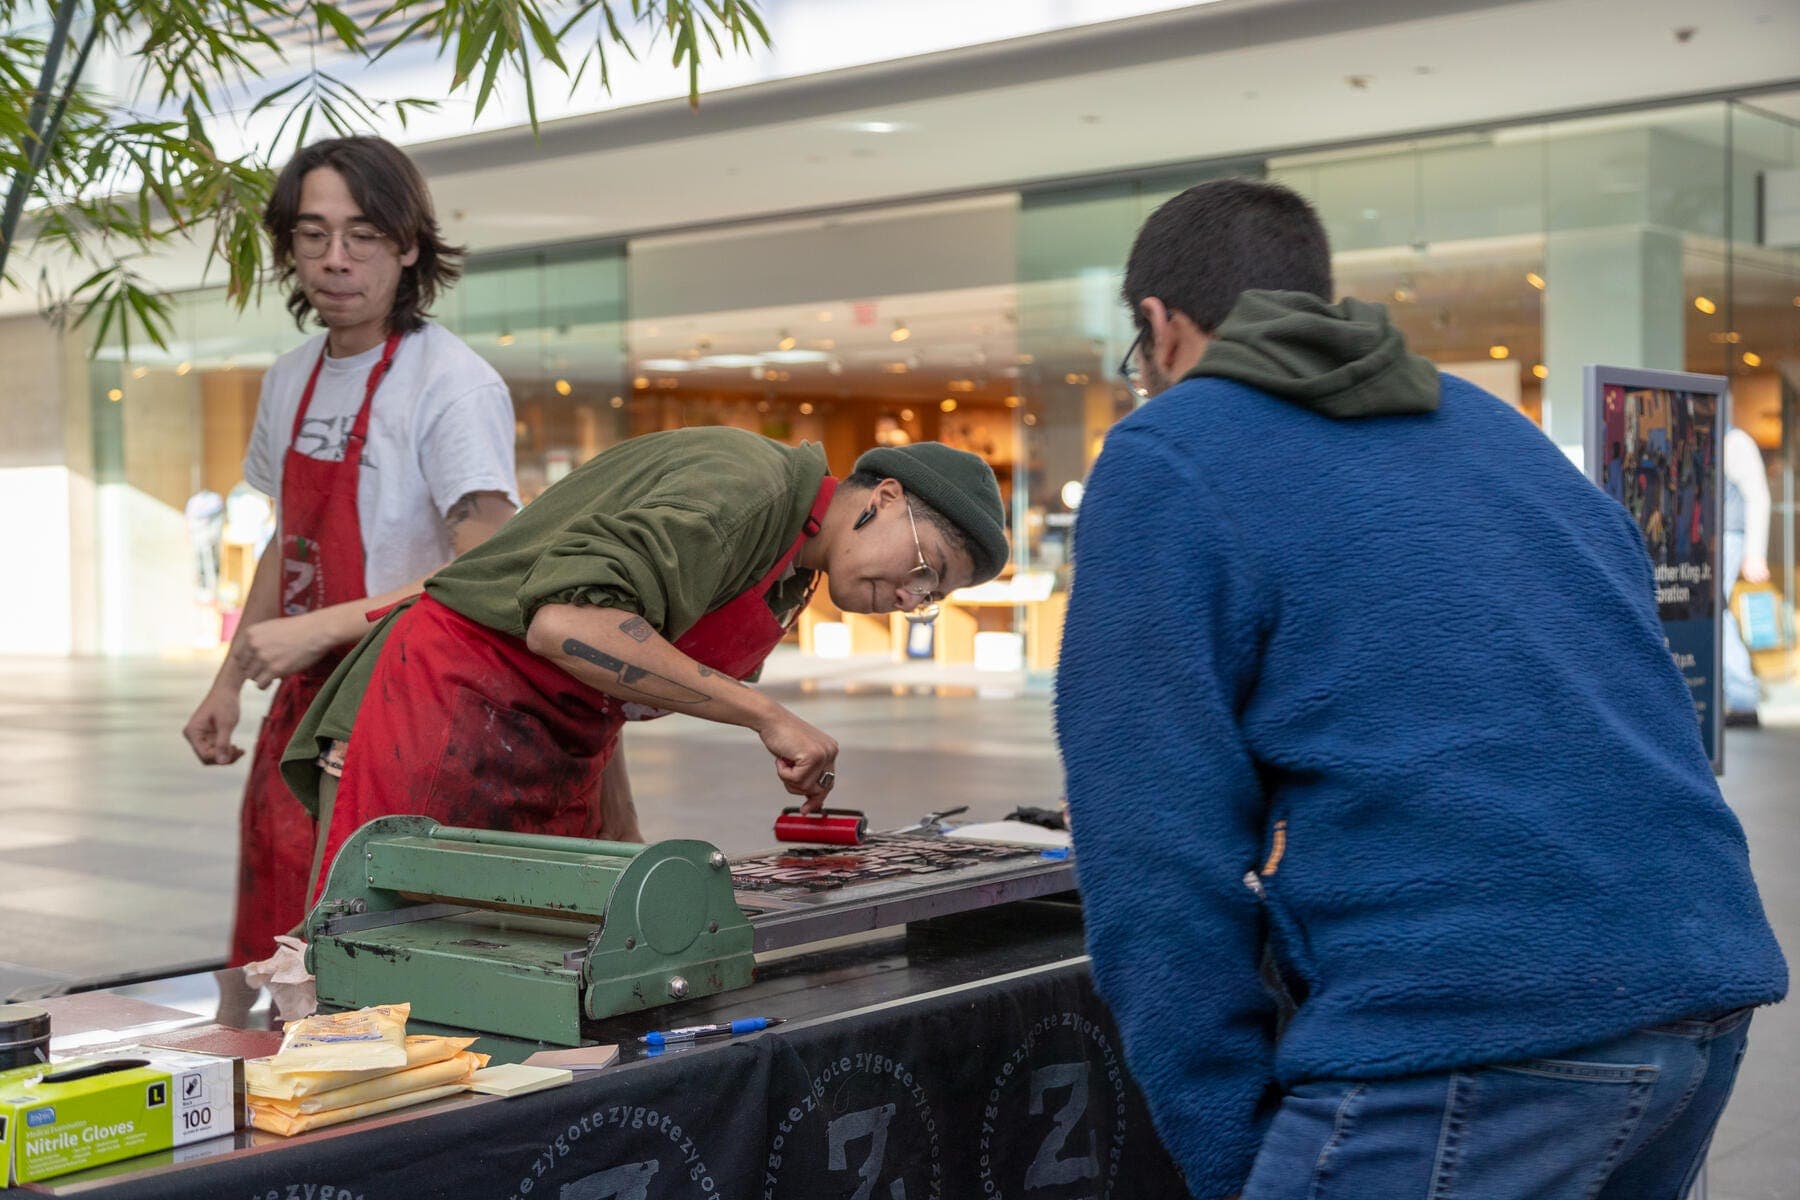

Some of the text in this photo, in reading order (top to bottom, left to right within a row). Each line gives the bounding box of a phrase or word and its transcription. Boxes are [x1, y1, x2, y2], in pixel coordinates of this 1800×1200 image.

[1654, 563, 1678, 581] uther
[1679, 562, 1700, 584] King
[1061, 1012, 1107, 1048] zyote
[801, 1057, 851, 1112] zgote
[856, 1052, 913, 1087] zygote
[182, 1107, 211, 1129] 100
[1024, 1061, 1100, 1190] Z
[26, 1132, 78, 1157] Nitrile
[82, 1120, 134, 1142] Gloves
[531, 1111, 604, 1177] zygote
[608, 1105, 682, 1142] zygote
